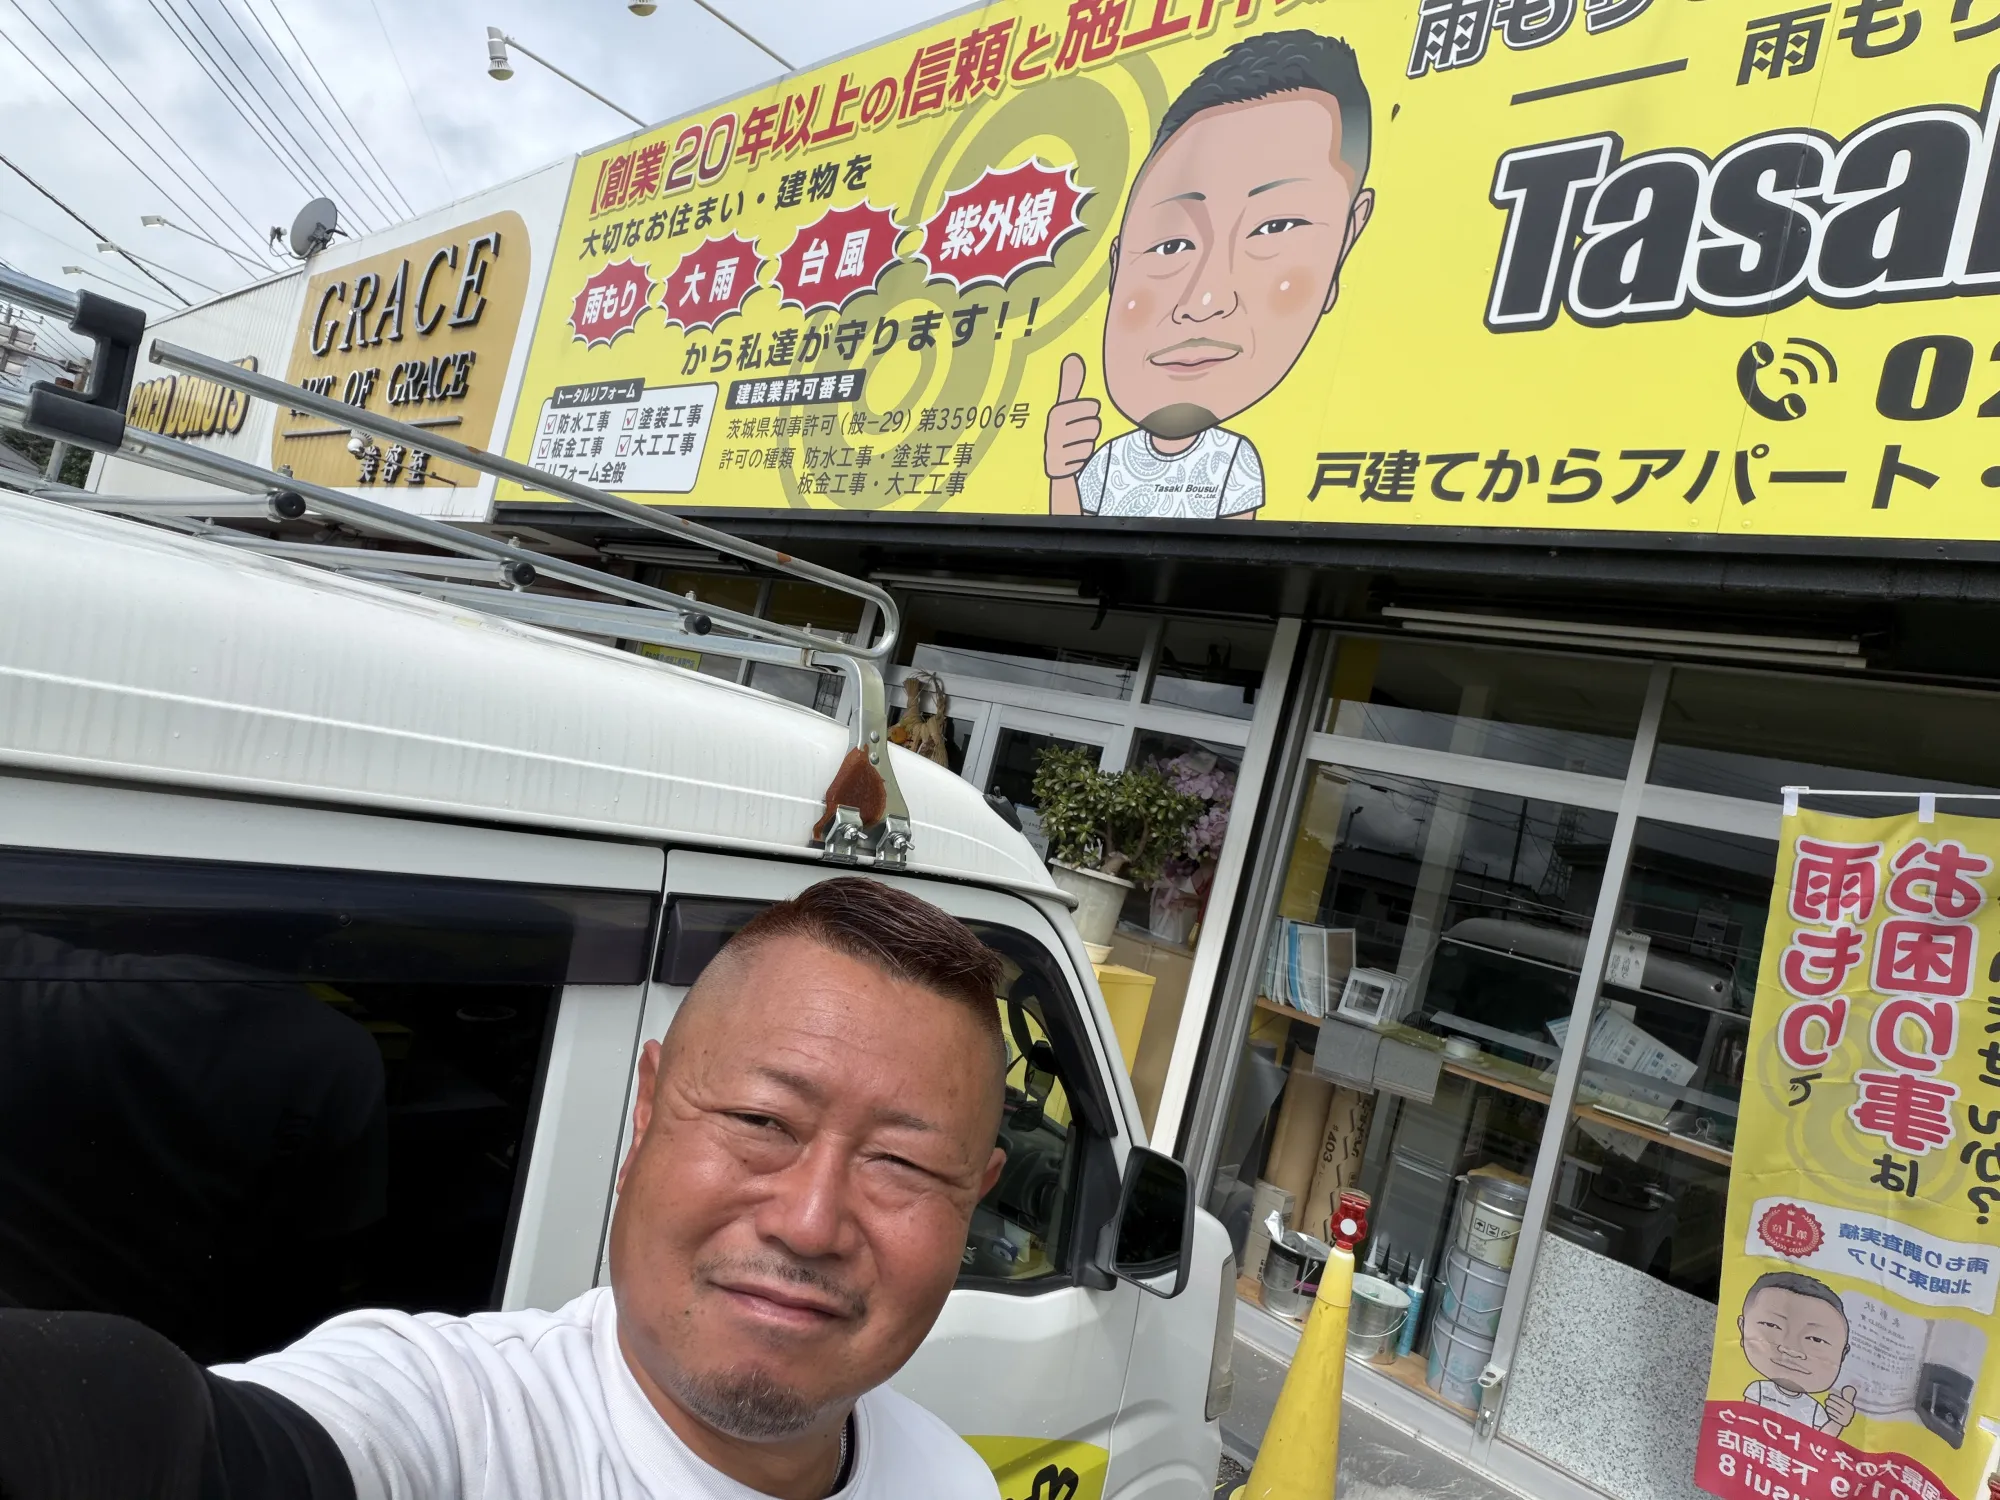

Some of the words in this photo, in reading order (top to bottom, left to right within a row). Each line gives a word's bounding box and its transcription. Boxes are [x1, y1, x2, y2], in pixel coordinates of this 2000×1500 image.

[579, 154, 873, 260] 大切なお住まい・建物を
[939, 188, 1059, 263] 紫外線
[1485, 70, 2000, 334] Tasa
[678, 256, 741, 308] 大雨
[797, 228, 872, 288] 台風
[309, 232, 501, 357] GRACE
[581, 279, 639, 327] 雨もり
[342, 367, 381, 410] OF
[386, 350, 477, 406] GRACE
[556, 382, 636, 405] トータルリフォーム
[734, 373, 856, 405] 建設業許可番号
[1875, 334, 2000, 422] 0
[556, 410, 612, 435] 防水工事
[637, 403, 704, 430] 塗装工事
[551, 435, 606, 458] 板金工事
[631, 431, 697, 457] 大工工事
[718, 446, 797, 470] 許可の種類
[802, 441, 976, 470] 防水工事・塗装工事
[797, 470, 968, 497] 板金工事・大工工事
